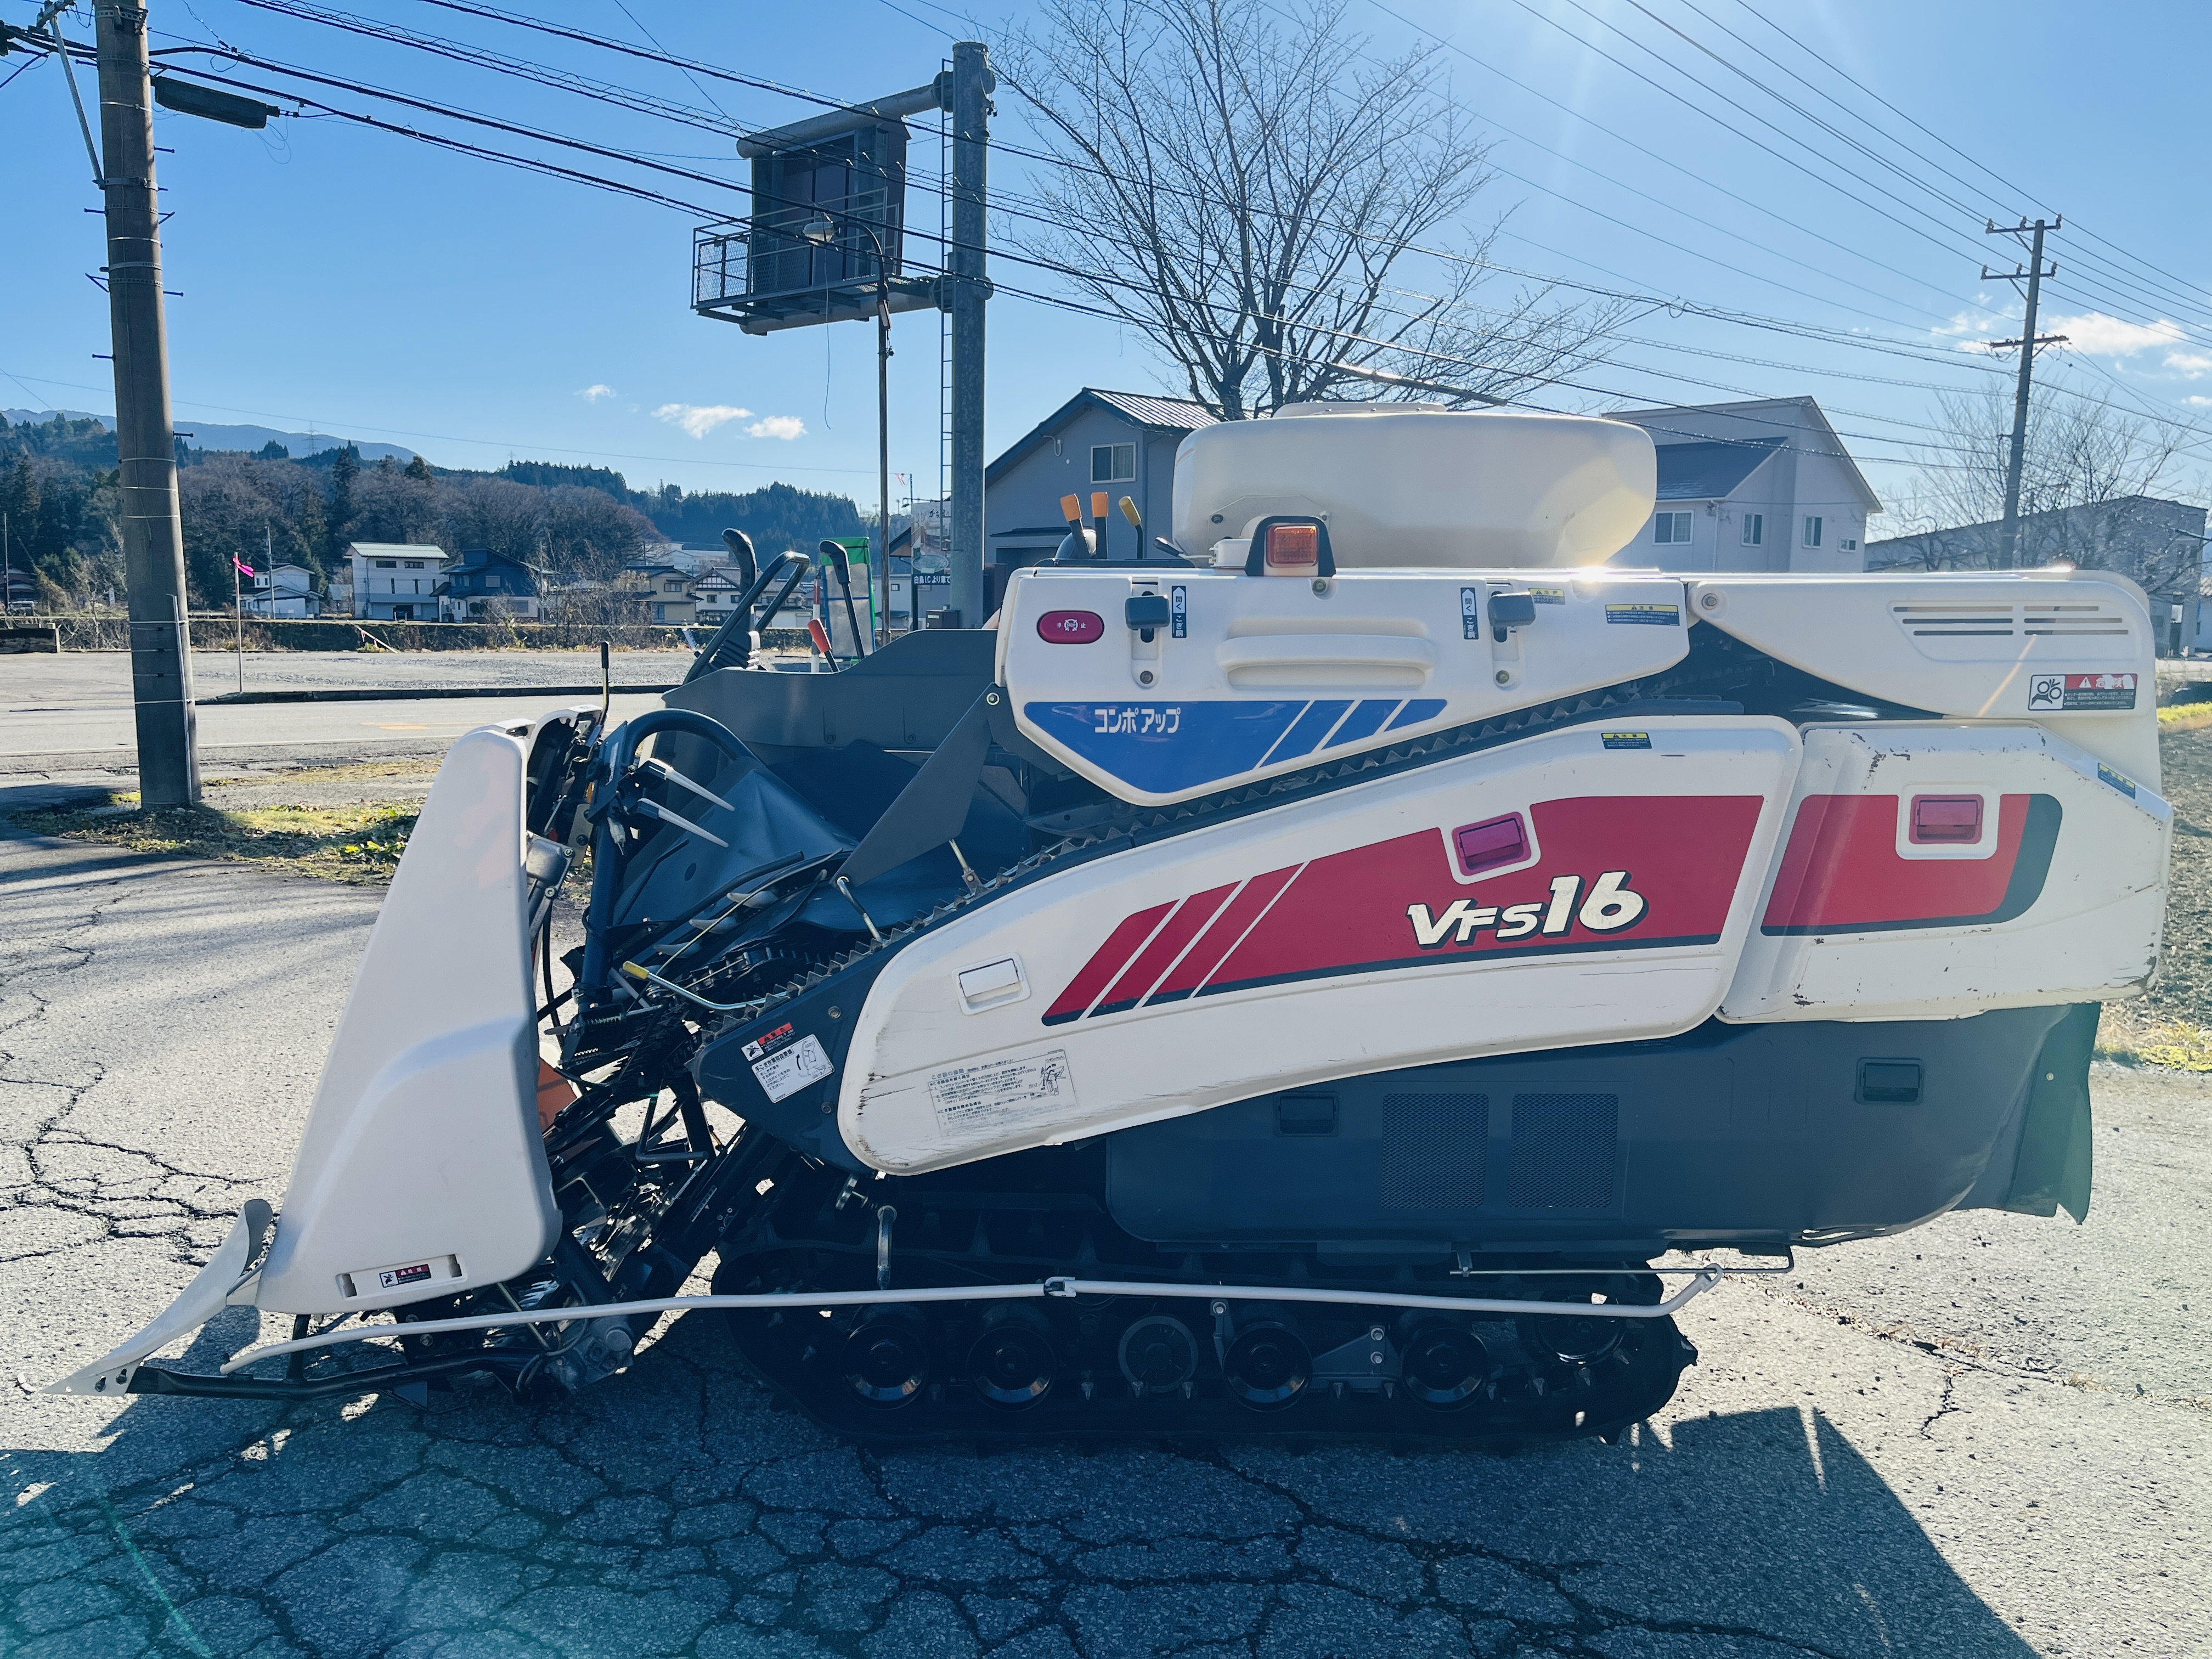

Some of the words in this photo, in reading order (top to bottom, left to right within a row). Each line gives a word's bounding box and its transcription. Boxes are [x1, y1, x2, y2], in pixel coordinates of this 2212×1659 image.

[1094, 707, 1181, 734] コンポアップ
[1406, 870, 1648, 949] VFS16
